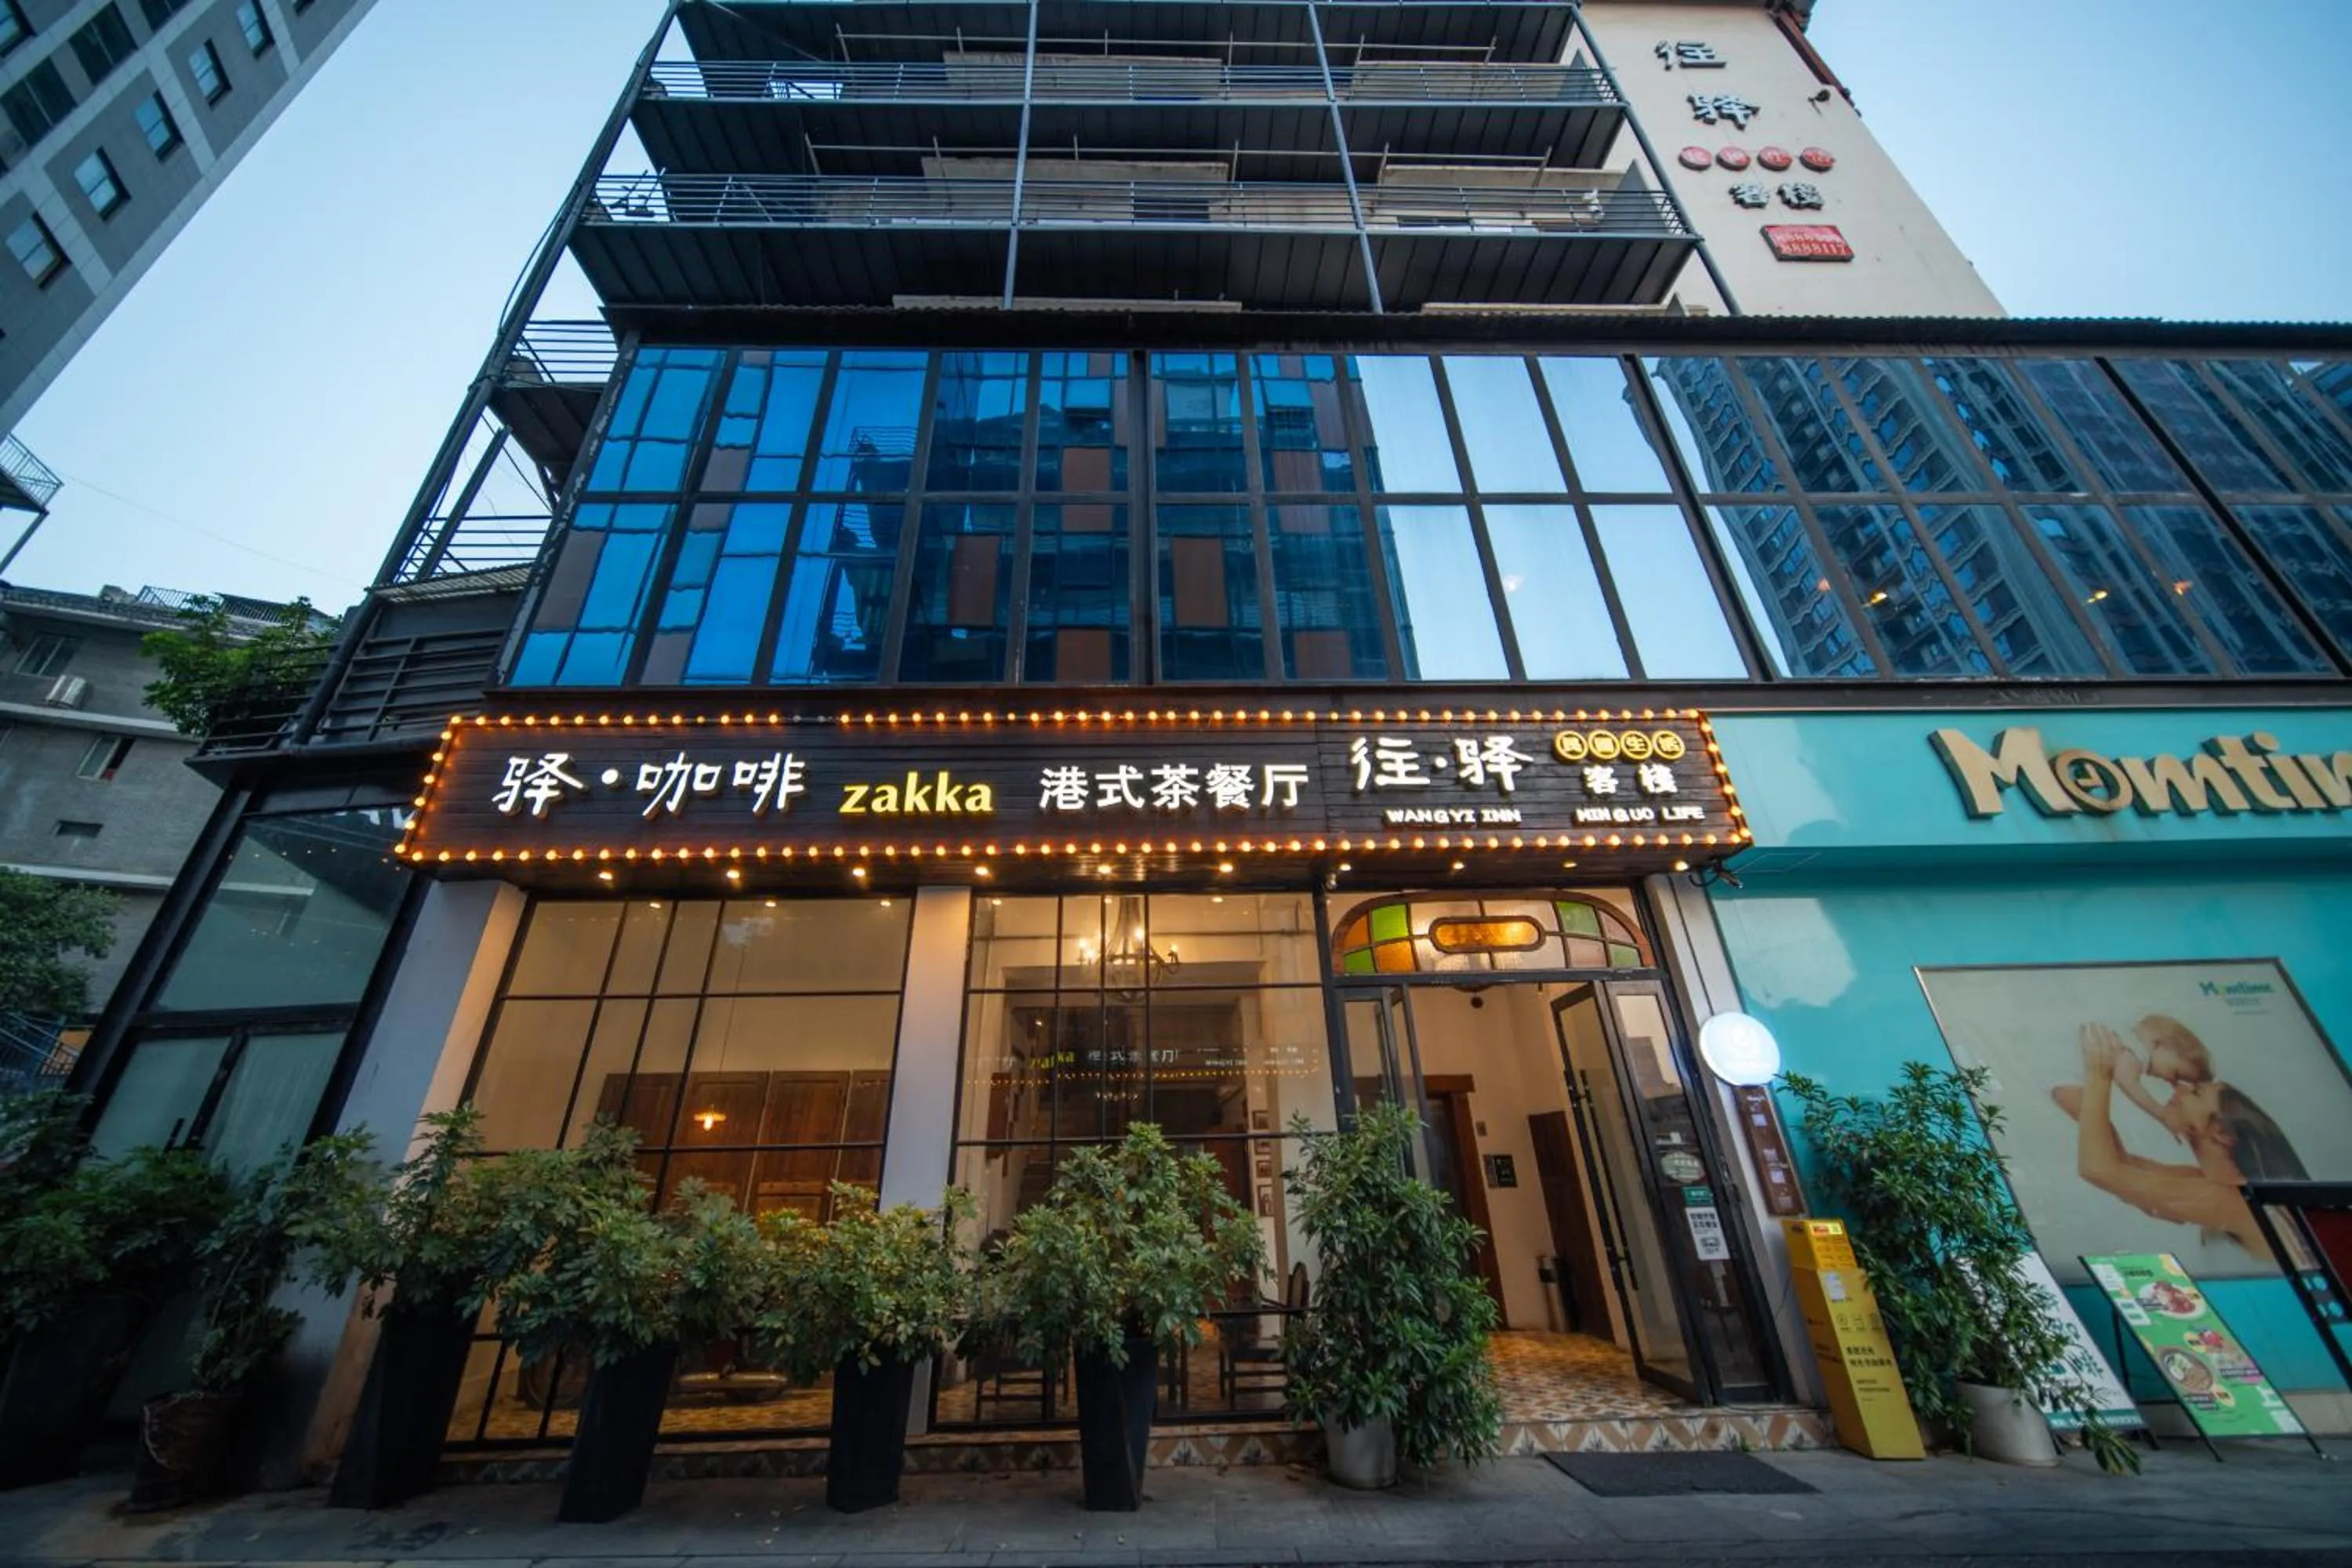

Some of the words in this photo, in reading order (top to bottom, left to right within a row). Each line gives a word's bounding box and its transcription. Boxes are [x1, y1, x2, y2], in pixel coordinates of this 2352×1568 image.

[839, 771, 993, 814] zakka
[1038, 762, 1309, 810] 港式茶餐厅
[1385, 808, 1475, 824] WANGYI
[1480, 808, 1522, 823] INN
[1661, 804, 1706, 821] LIFE
